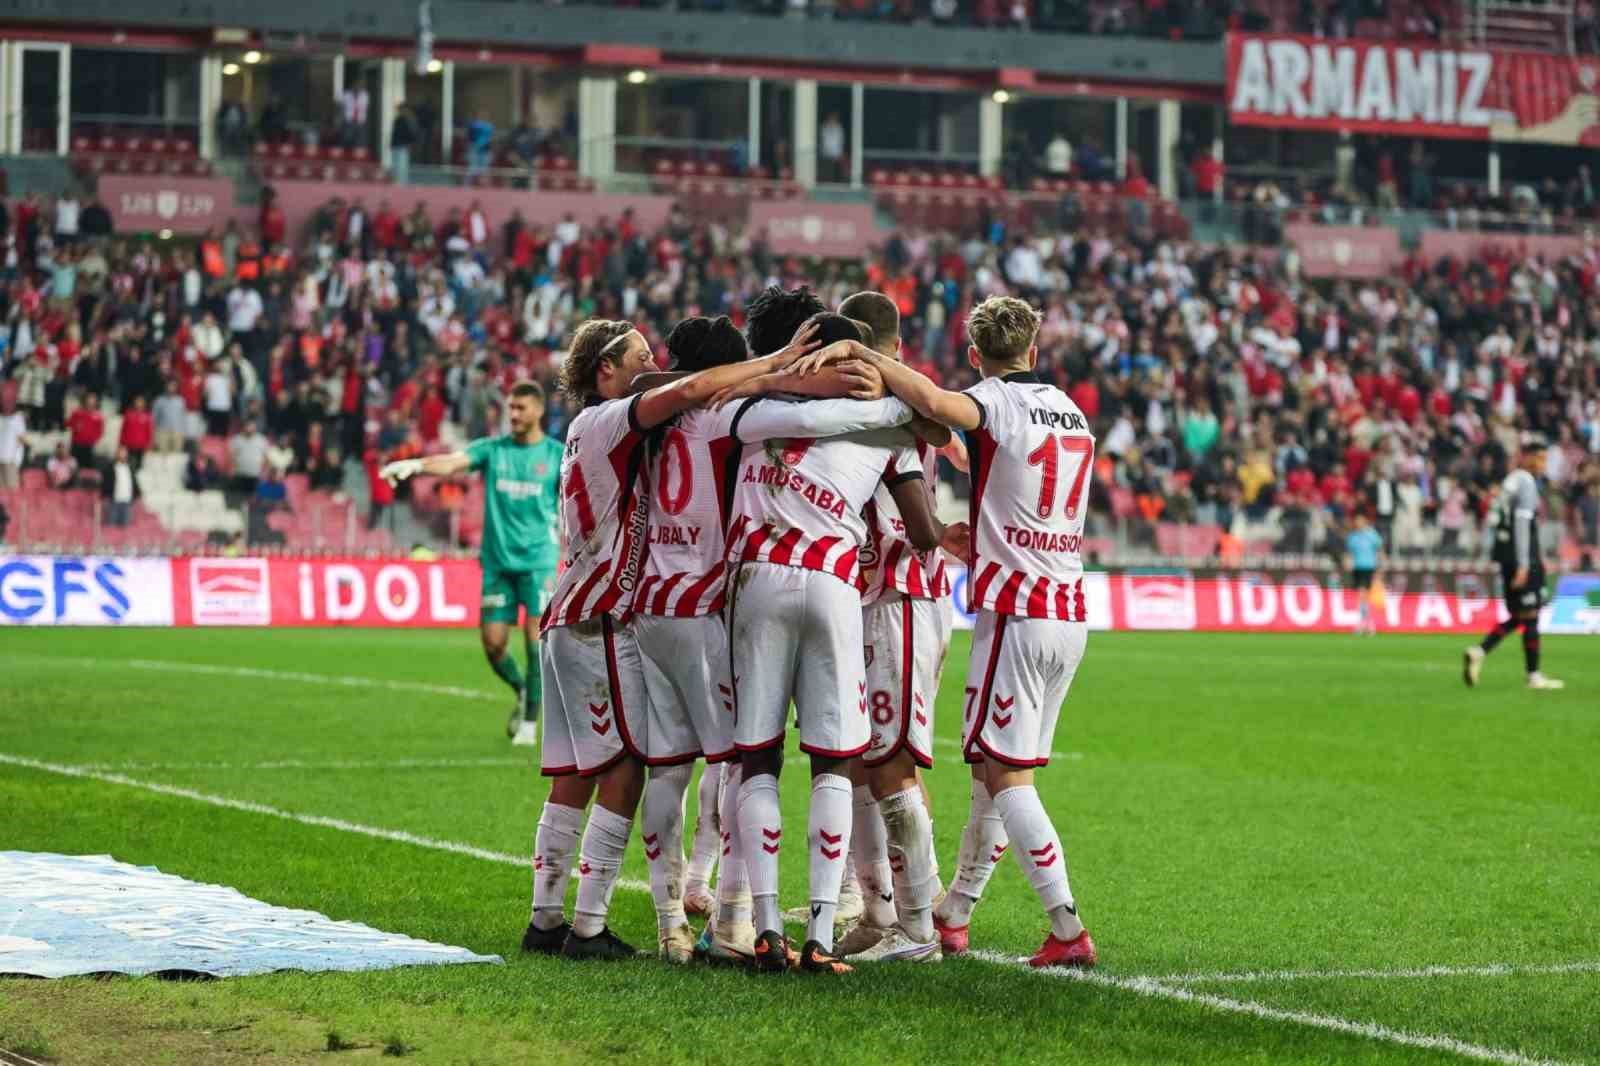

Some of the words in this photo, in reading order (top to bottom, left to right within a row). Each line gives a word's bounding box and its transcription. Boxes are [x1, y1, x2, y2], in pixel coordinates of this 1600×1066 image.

[1231, 38, 1493, 127] ARMAMIZ
[742, 464, 847, 520] A.MUSABA
[1027, 432, 1095, 519] 17
[0, 561, 130, 618] GFS
[871, 690, 895, 726] 8
